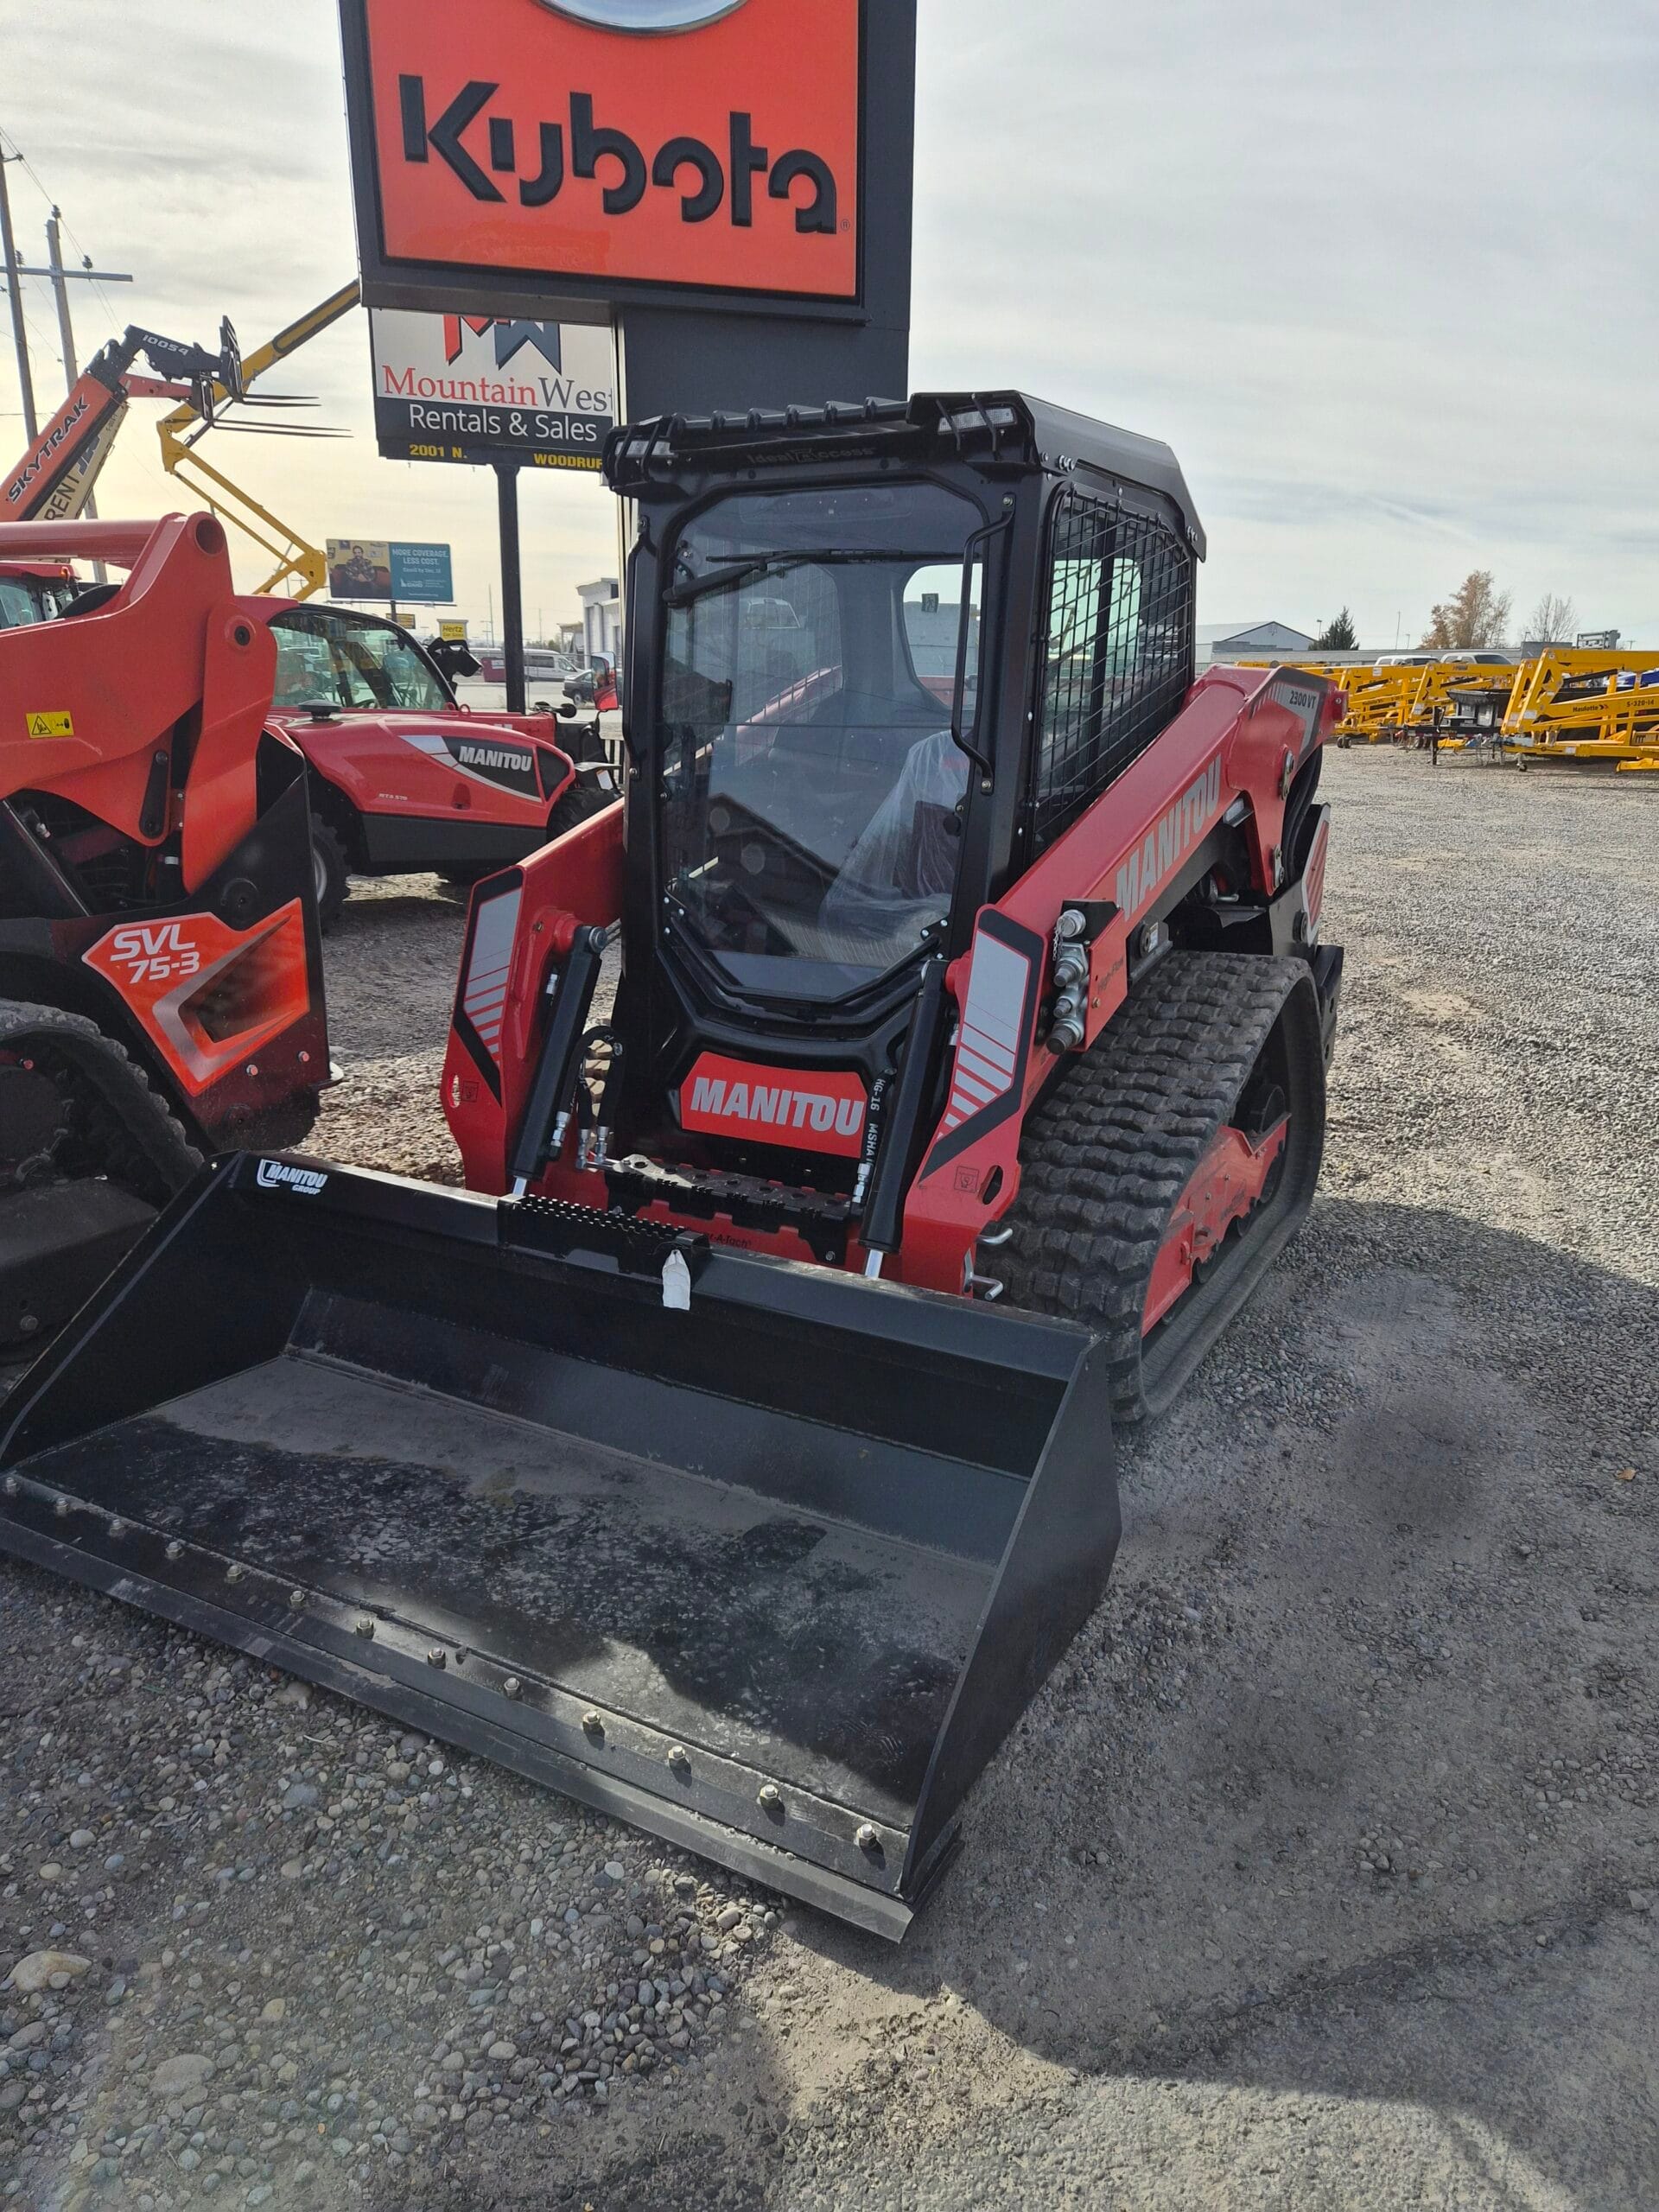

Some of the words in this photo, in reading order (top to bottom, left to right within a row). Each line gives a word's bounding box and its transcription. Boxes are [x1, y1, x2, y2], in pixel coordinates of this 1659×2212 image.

[398, 73, 837, 235] Kubota
[142, 334, 190, 356] 10054
[409, 404, 501, 435] Rentals
[508, 415, 528, 437] &
[535, 414, 597, 442] Sales
[8, 395, 90, 504] SKYTRAK
[409, 444, 445, 457] 2001
[452, 446, 468, 459] N.
[1307, 695, 1317, 709] VT
[458, 746, 533, 772] MANITOU
[1116, 753, 1222, 922] MANITOU
[110, 924, 196, 962] SVL
[128, 951, 200, 984] 75-3
[690, 1077, 865, 1136] MANITOU
[265, 1164, 328, 1188] MANITOU
[291, 1184, 321, 1195] GROUP
